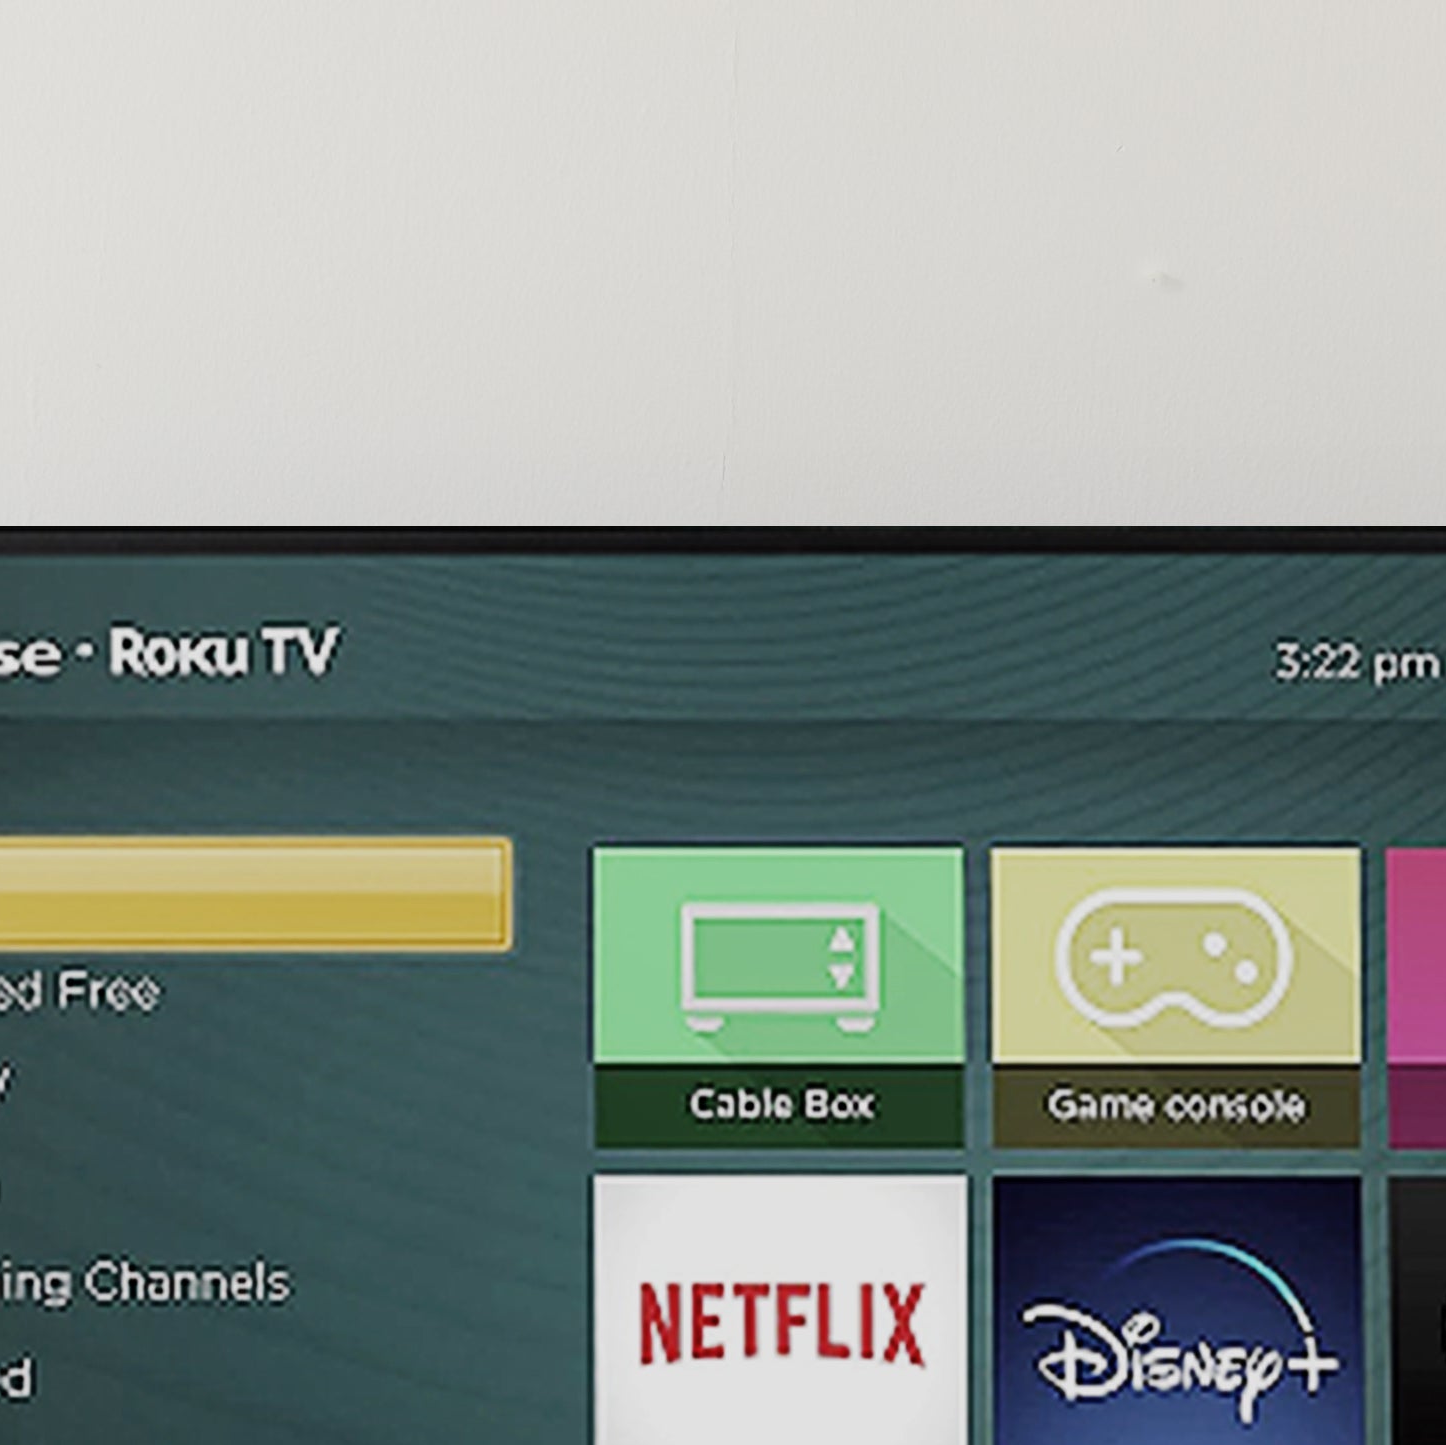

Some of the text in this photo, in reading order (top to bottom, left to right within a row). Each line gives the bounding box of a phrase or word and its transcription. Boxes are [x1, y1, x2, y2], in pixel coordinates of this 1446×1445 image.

[110, 627, 249, 677] Roku
[261, 627, 340, 675] TV
[1277, 643, 1440, 686] 3:22 pm
[59, 970, 160, 1011] Free
[690, 1088, 874, 1119] Cable Box
[1048, 1088, 1305, 1123] Game console
[85, 1260, 290, 1301] Channels
[640, 1282, 925, 1367] NETFLIX
